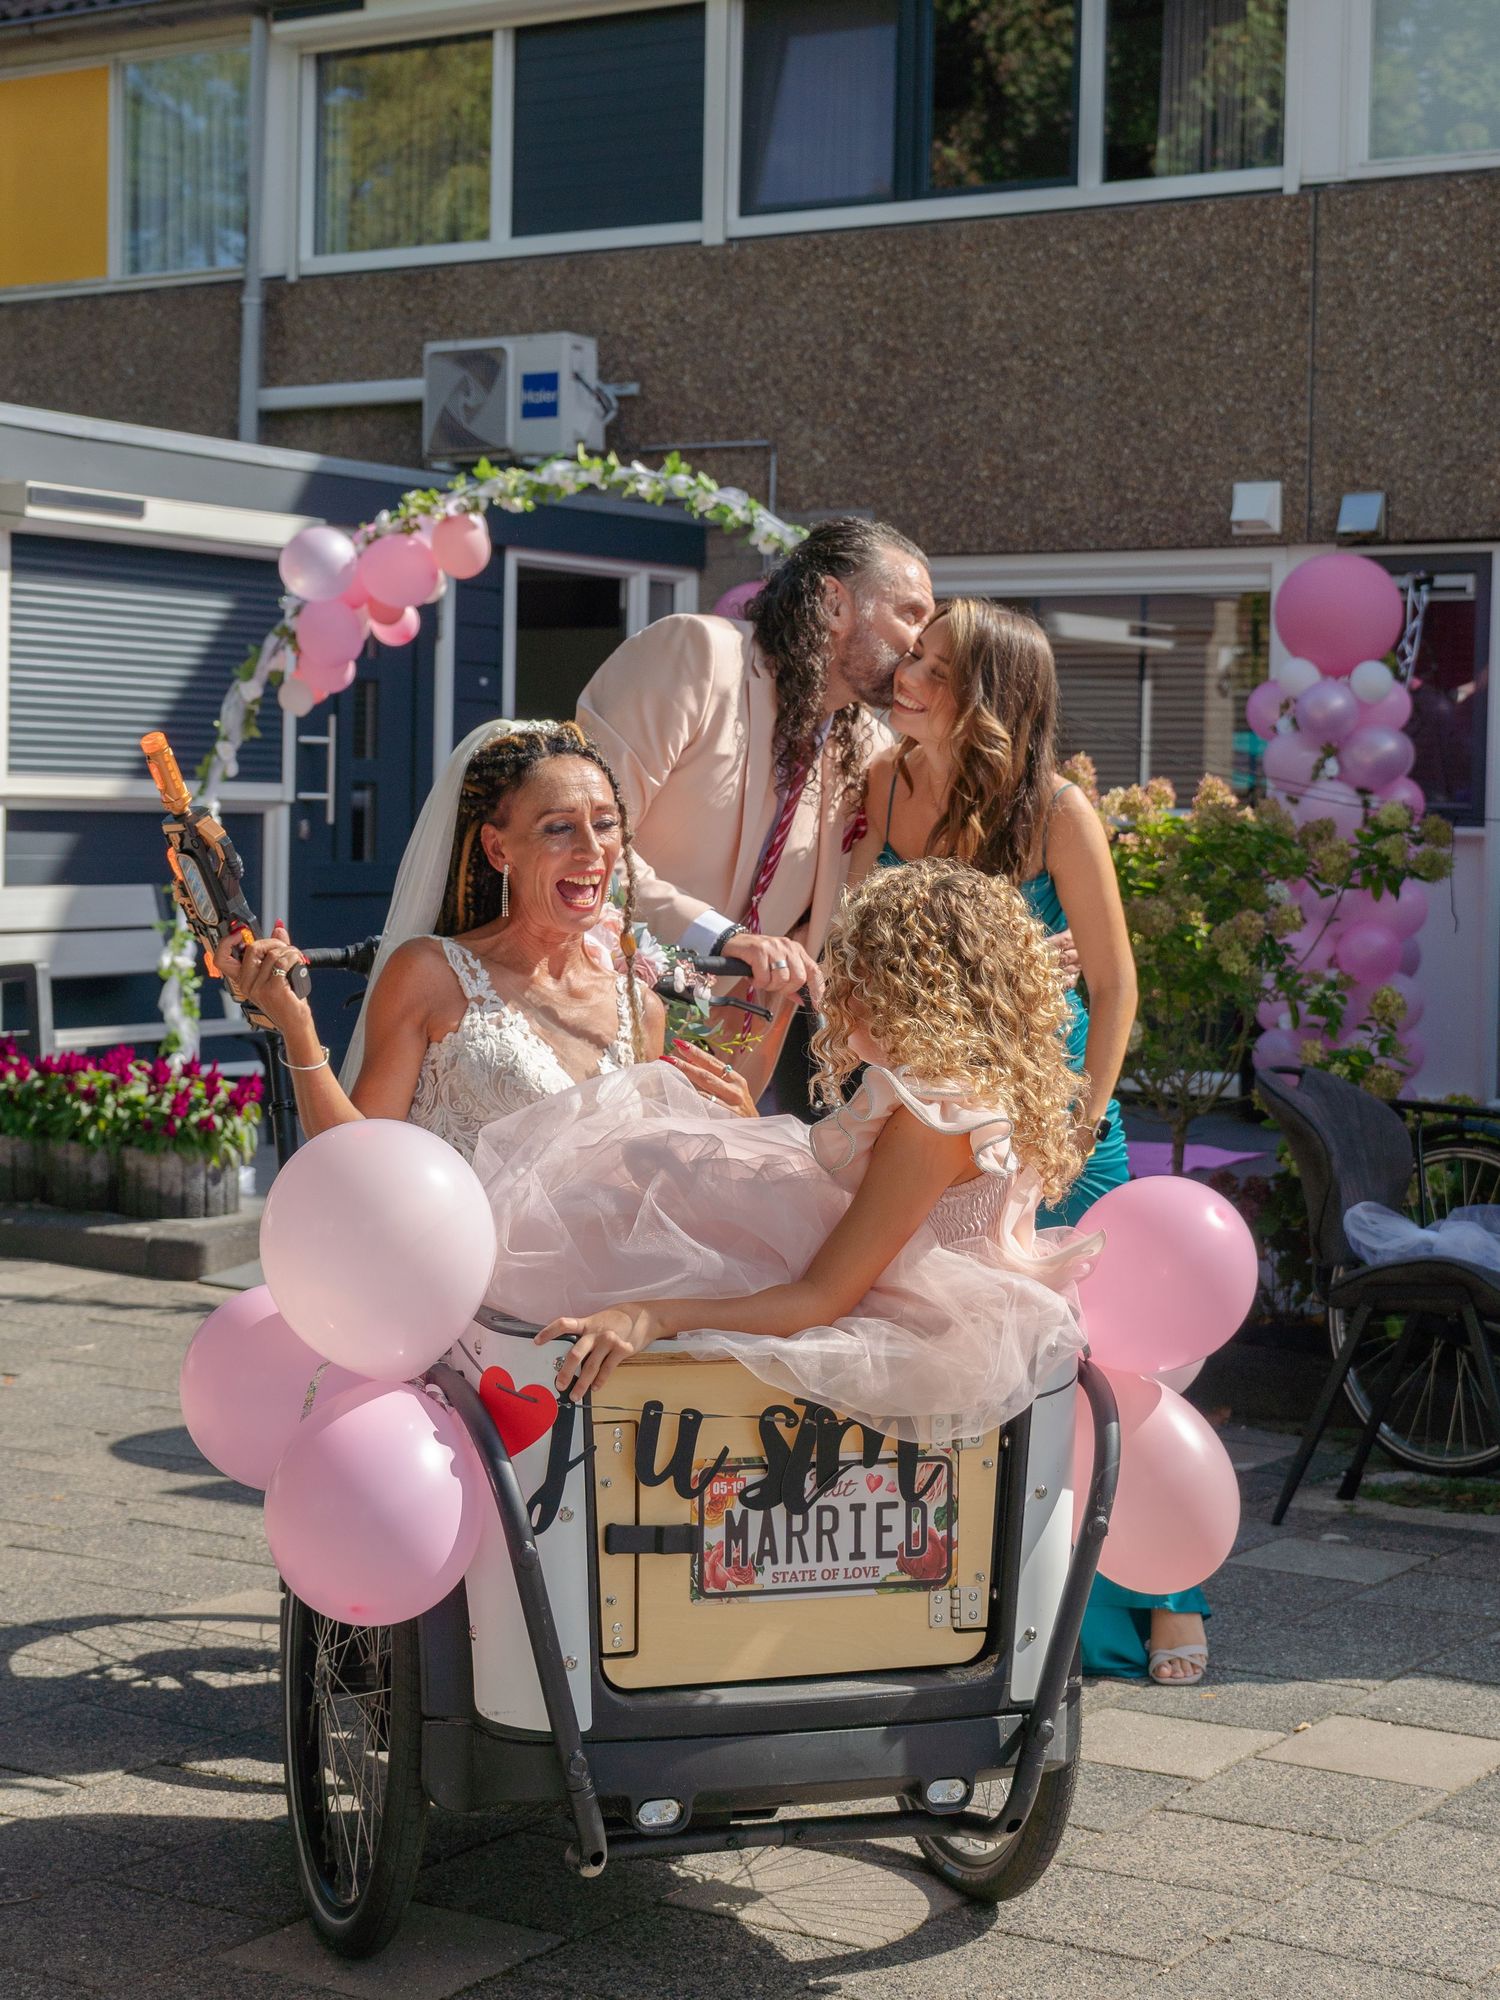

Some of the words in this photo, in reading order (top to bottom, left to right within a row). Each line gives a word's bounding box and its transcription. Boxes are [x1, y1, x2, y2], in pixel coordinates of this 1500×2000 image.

[523, 388, 558, 404] Haier
[724, 1501, 928, 1568] MARRIED
[771, 1568, 817, 1584] STATE
[821, 1568, 840, 1580] OF
[844, 1565, 880, 1579] LOVE
